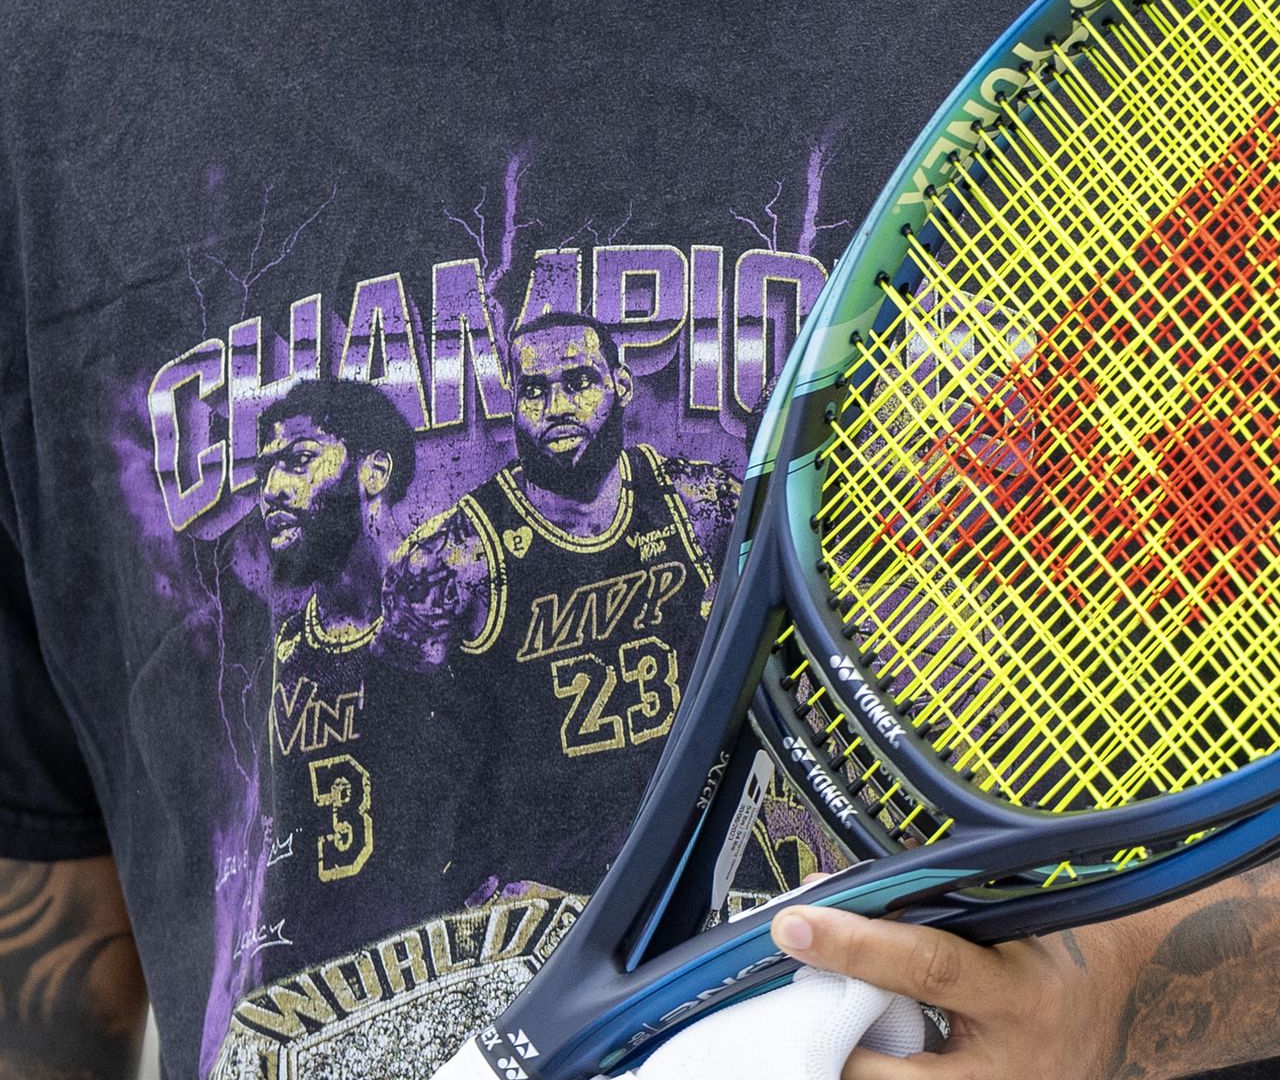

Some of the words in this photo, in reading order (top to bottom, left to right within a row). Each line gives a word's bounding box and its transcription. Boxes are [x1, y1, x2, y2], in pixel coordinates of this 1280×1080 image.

[516, 560, 687, 662] MVP
[550, 635, 681, 758] 23
[853, 683, 908, 745] YONEX
[308, 753, 374, 883] 3
[806, 763, 859, 824] YONEX
[233, 897, 550, 1037] WORLD
